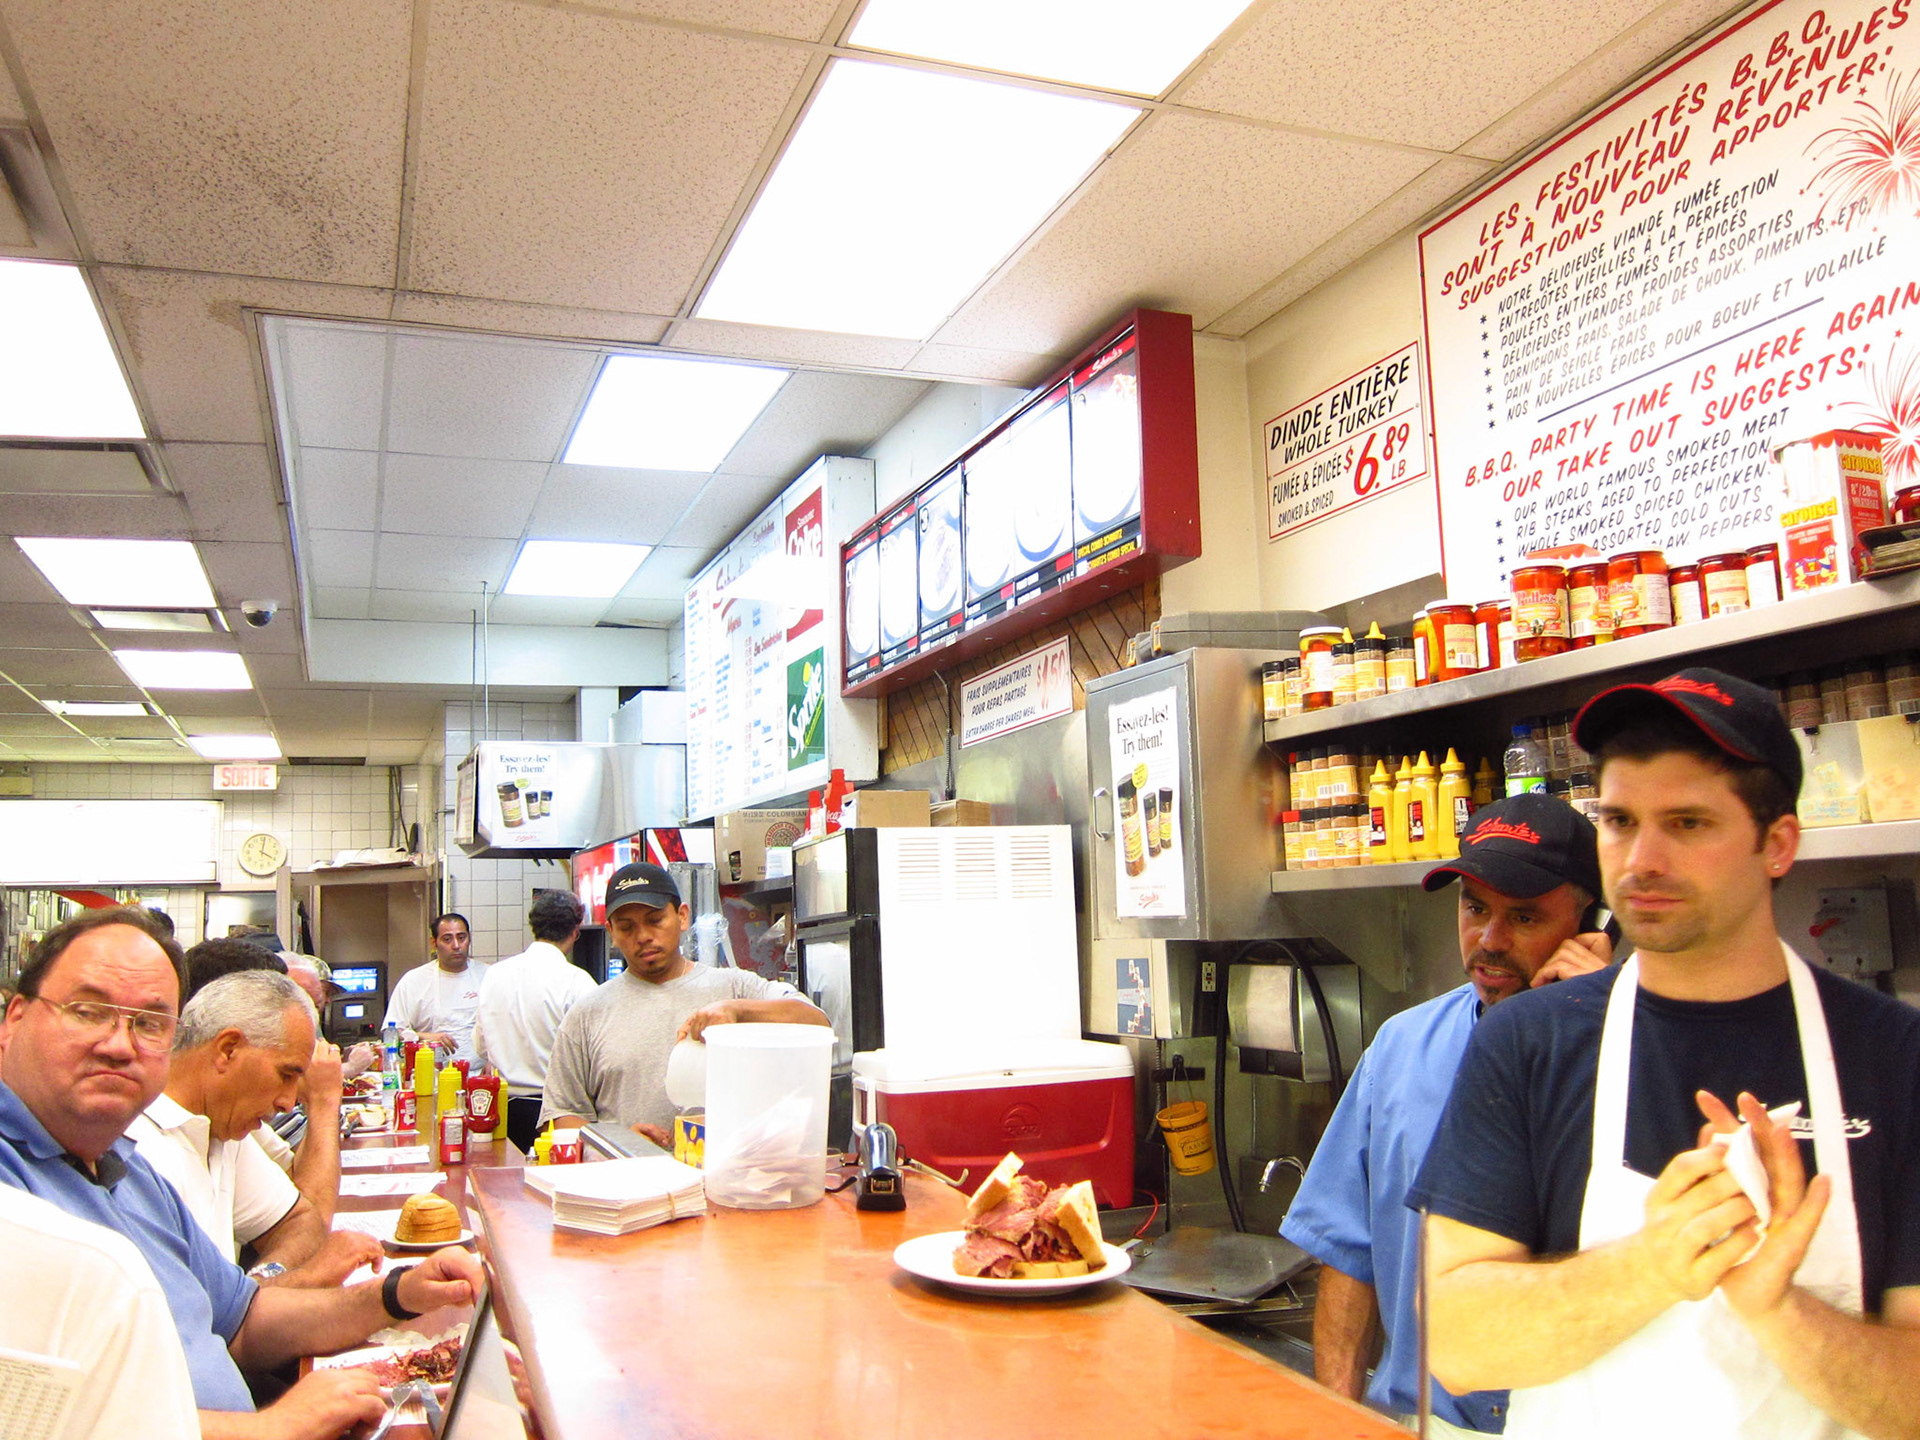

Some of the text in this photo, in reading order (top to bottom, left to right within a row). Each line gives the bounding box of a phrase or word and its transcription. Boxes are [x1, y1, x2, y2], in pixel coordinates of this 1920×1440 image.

[1441, 0, 1911, 296] SONT À NOUVEAU REVENUES
[1458, 46, 1893, 310] SUGGESTIONS POUR APPORTER:
[1480, 203, 1519, 246] LES
[1536, 82, 1708, 210] FESTIVITÉS
[1498, 178, 1721, 315] NOTRE DÉLICIEUSE VIANDE FUMÉE
[1575, 246, 1635, 291] VIEILLIES
[1661, 225, 1676, 246] LA
[1685, 168, 1779, 232] PERFECTION
[1501, 209, 1747, 350] POULETS ENTIERS FUMÉS ET ÉPICÉS
[1502, 209, 1793, 369] DÉLICIEUSES VIANDES FROIDES ASSORTIES
[1503, 342, 1569, 387] CORNICHONS
[1618, 296, 1663, 331] SALADE
[1671, 284, 1688, 305] DE
[1505, 323, 1648, 403] PAIN DE SEIGLE FRAIS
[1507, 235, 1887, 422] NOS NOUVELLES ÉPICES POUR BOEUF ET VOLAILLE
[1270, 356, 1410, 450] DINDE ENTIÈRE
[1284, 389, 1399, 464] WHOLE TURKEY
[1503, 343, 1871, 502] OUR TAKE OUT SUGGESTS:
[1529, 413, 1598, 460] PARTY
[1612, 382, 1673, 426] TIME
[1690, 364, 1716, 395] IS
[1734, 326, 1806, 377] HERE
[1272, 473, 1300, 506] FUMÉE
[1302, 473, 1309, 492] &
[1312, 452, 1342, 488] ÉPICÉE
[1391, 459, 1407, 481] LB
[1514, 406, 1790, 522] OUR WORLD FAMOUS SMOKED MEAT
[1516, 436, 1772, 540] RIB STEAKS AGED TO PERFECTION
[788, 522, 823, 558] Coke
[1278, 490, 1334, 528] SMOKED & SPICED
[1518, 532, 1560, 558] WHOLE
[1569, 509, 1625, 548] SMOKED
[1634, 488, 1685, 521] SPICED
[1592, 520, 1662, 552] ASSORTED
[1671, 502, 1709, 528] COLD
[1719, 485, 1762, 513] CUTS
[1700, 505, 1773, 540] PEPPERS
[1780, 497, 1838, 528] carousel
[788, 661, 822, 759] Sprite
[966, 685, 981, 702] FRAIS
[971, 702, 985, 717] POUR
[986, 694, 1003, 710] REPAS
[221, 766, 270, 787] SORTIE
[505, 764, 545, 775] Try them!
[1122, 730, 1162, 757] Try them!
